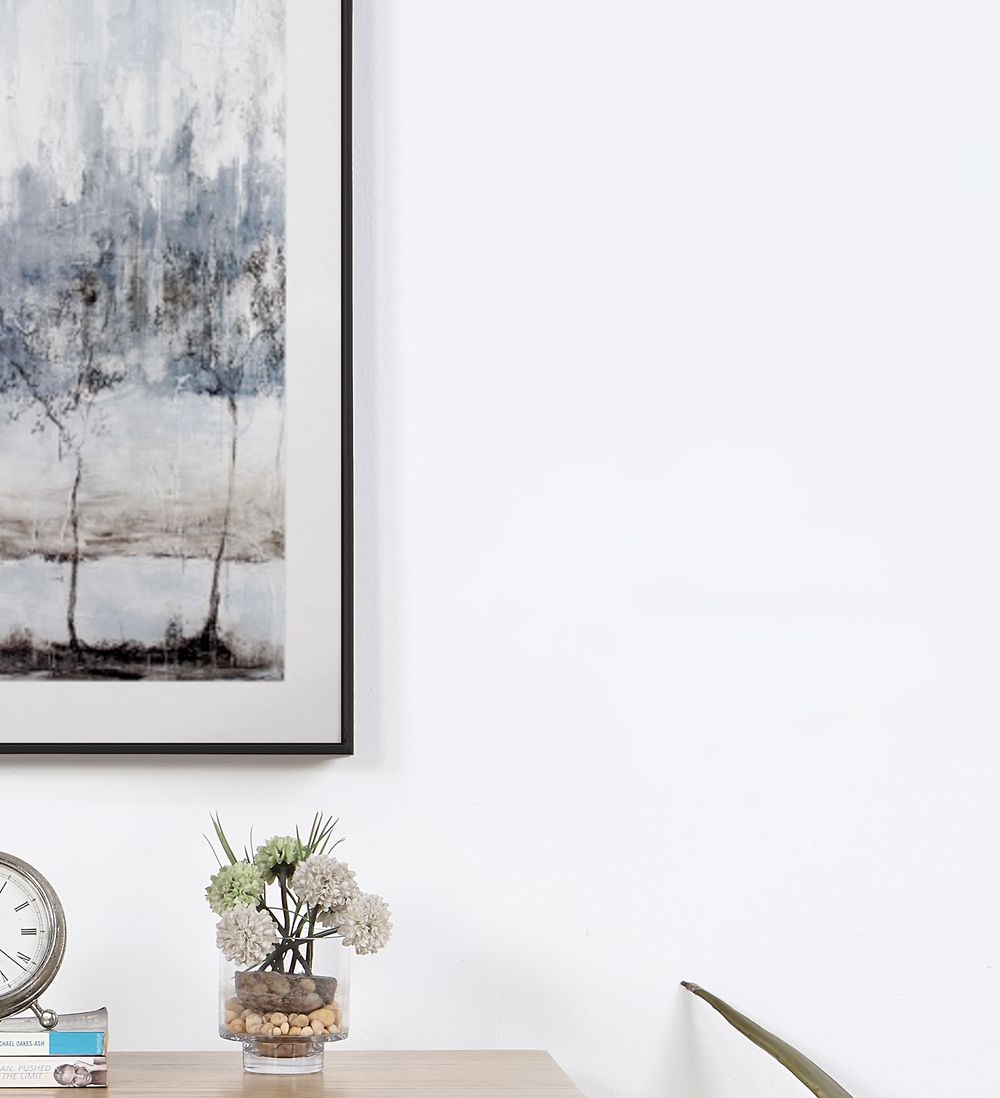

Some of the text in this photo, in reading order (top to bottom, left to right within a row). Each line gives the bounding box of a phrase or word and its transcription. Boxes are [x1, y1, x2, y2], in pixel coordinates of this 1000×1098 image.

[14, 901, 30, 913] II
[20, 928, 37, 936] III
[2, 1072, 18, 1080] THE
[20, 1072, 44, 1080] LIMIT
